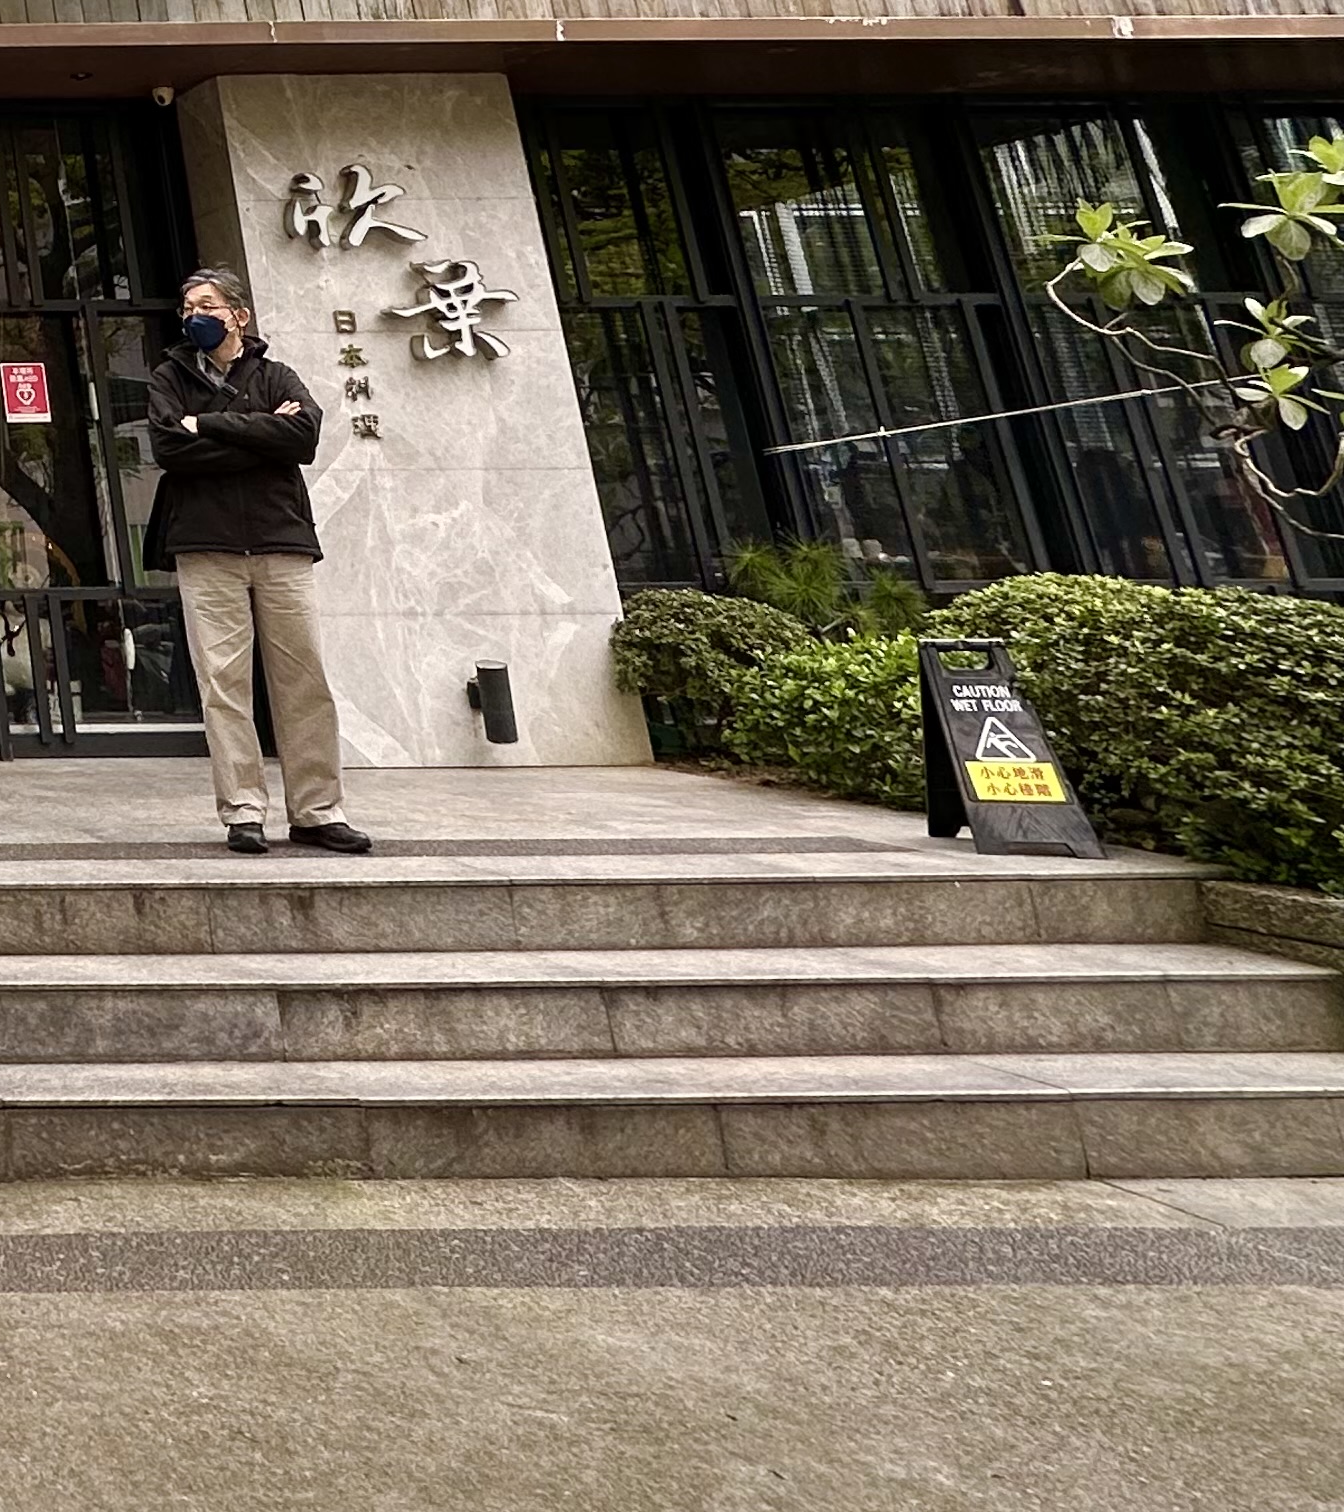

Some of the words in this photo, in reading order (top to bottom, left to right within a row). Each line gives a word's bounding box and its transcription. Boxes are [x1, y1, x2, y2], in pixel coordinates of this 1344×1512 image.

[333, 310, 383, 440] 日本料理
[952, 685, 1011, 698] CAUTION
[950, 699, 979, 712] WET
[983, 699, 1023, 712] FLOOR
[980, 766, 1045, 780] 小心地滑
